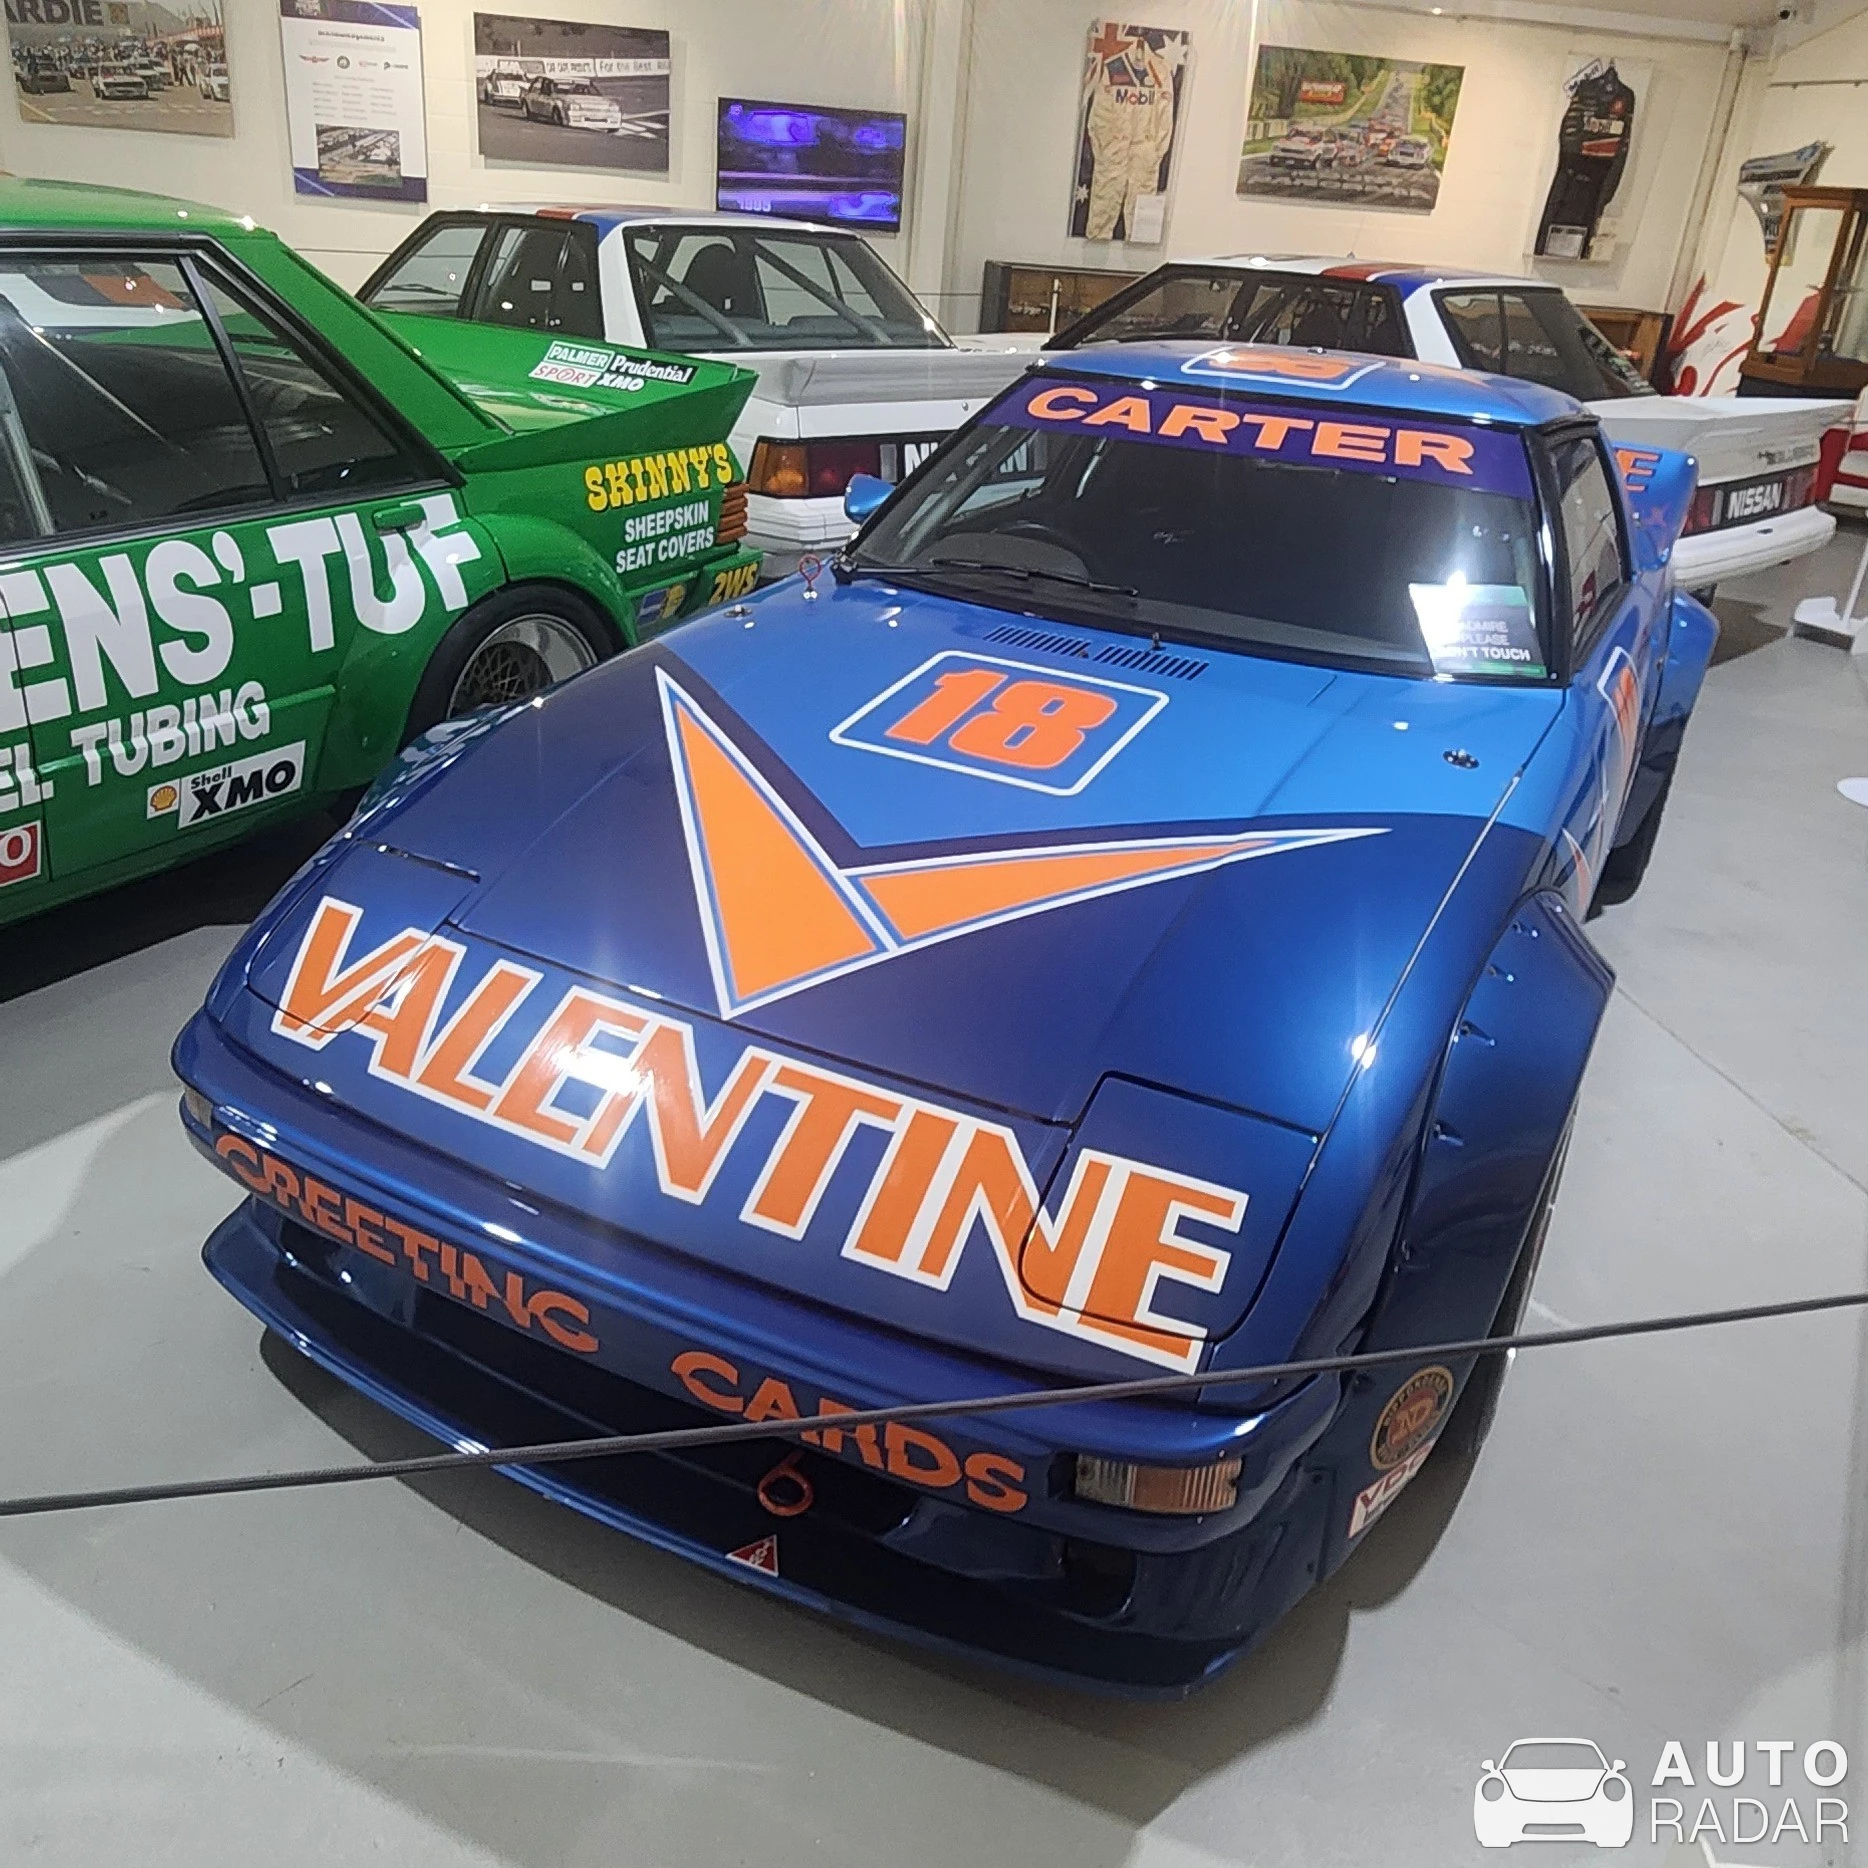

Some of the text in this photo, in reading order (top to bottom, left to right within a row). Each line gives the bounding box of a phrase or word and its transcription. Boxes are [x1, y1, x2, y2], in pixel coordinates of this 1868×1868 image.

[1115, 88, 1156, 105] Mobil
[549, 346, 609, 368] PALMER
[610, 355, 694, 383] Prudential
[596, 373, 646, 392] XMO
[1026, 387, 1476, 476] CARTER
[584, 442, 734, 512] SKINNY'S
[624, 500, 710, 543] SHEEPSKIN
[1727, 482, 1783, 520] NISSAN
[616, 528, 714, 574] SEAT COVERS
[1481, 647, 1532, 662] TOUCH
[70, 681, 270, 787] TUBING
[884, 668, 1118, 770] 18
[189, 760, 297, 823] XMO
[191, 766, 233, 791] Shell
[270, 895, 1250, 1376] VALENTINE
[215, 1133, 1028, 1514] GREETING CARDS
